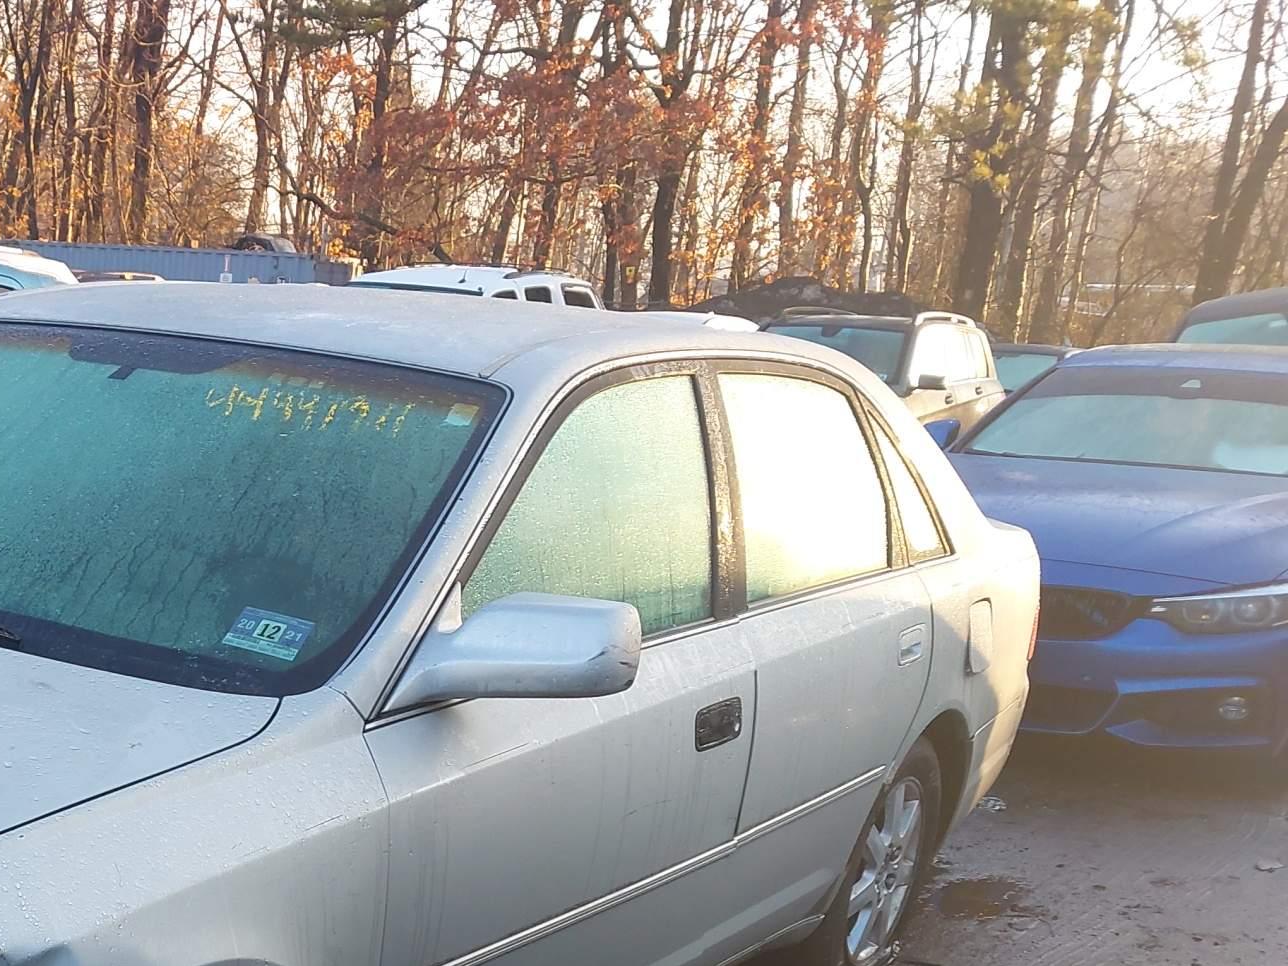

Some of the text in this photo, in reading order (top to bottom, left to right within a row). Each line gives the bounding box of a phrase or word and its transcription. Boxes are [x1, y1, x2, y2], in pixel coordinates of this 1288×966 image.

[237, 618, 256, 630] 20
[257, 623, 282, 640] 12
[284, 630, 303, 642] 21
